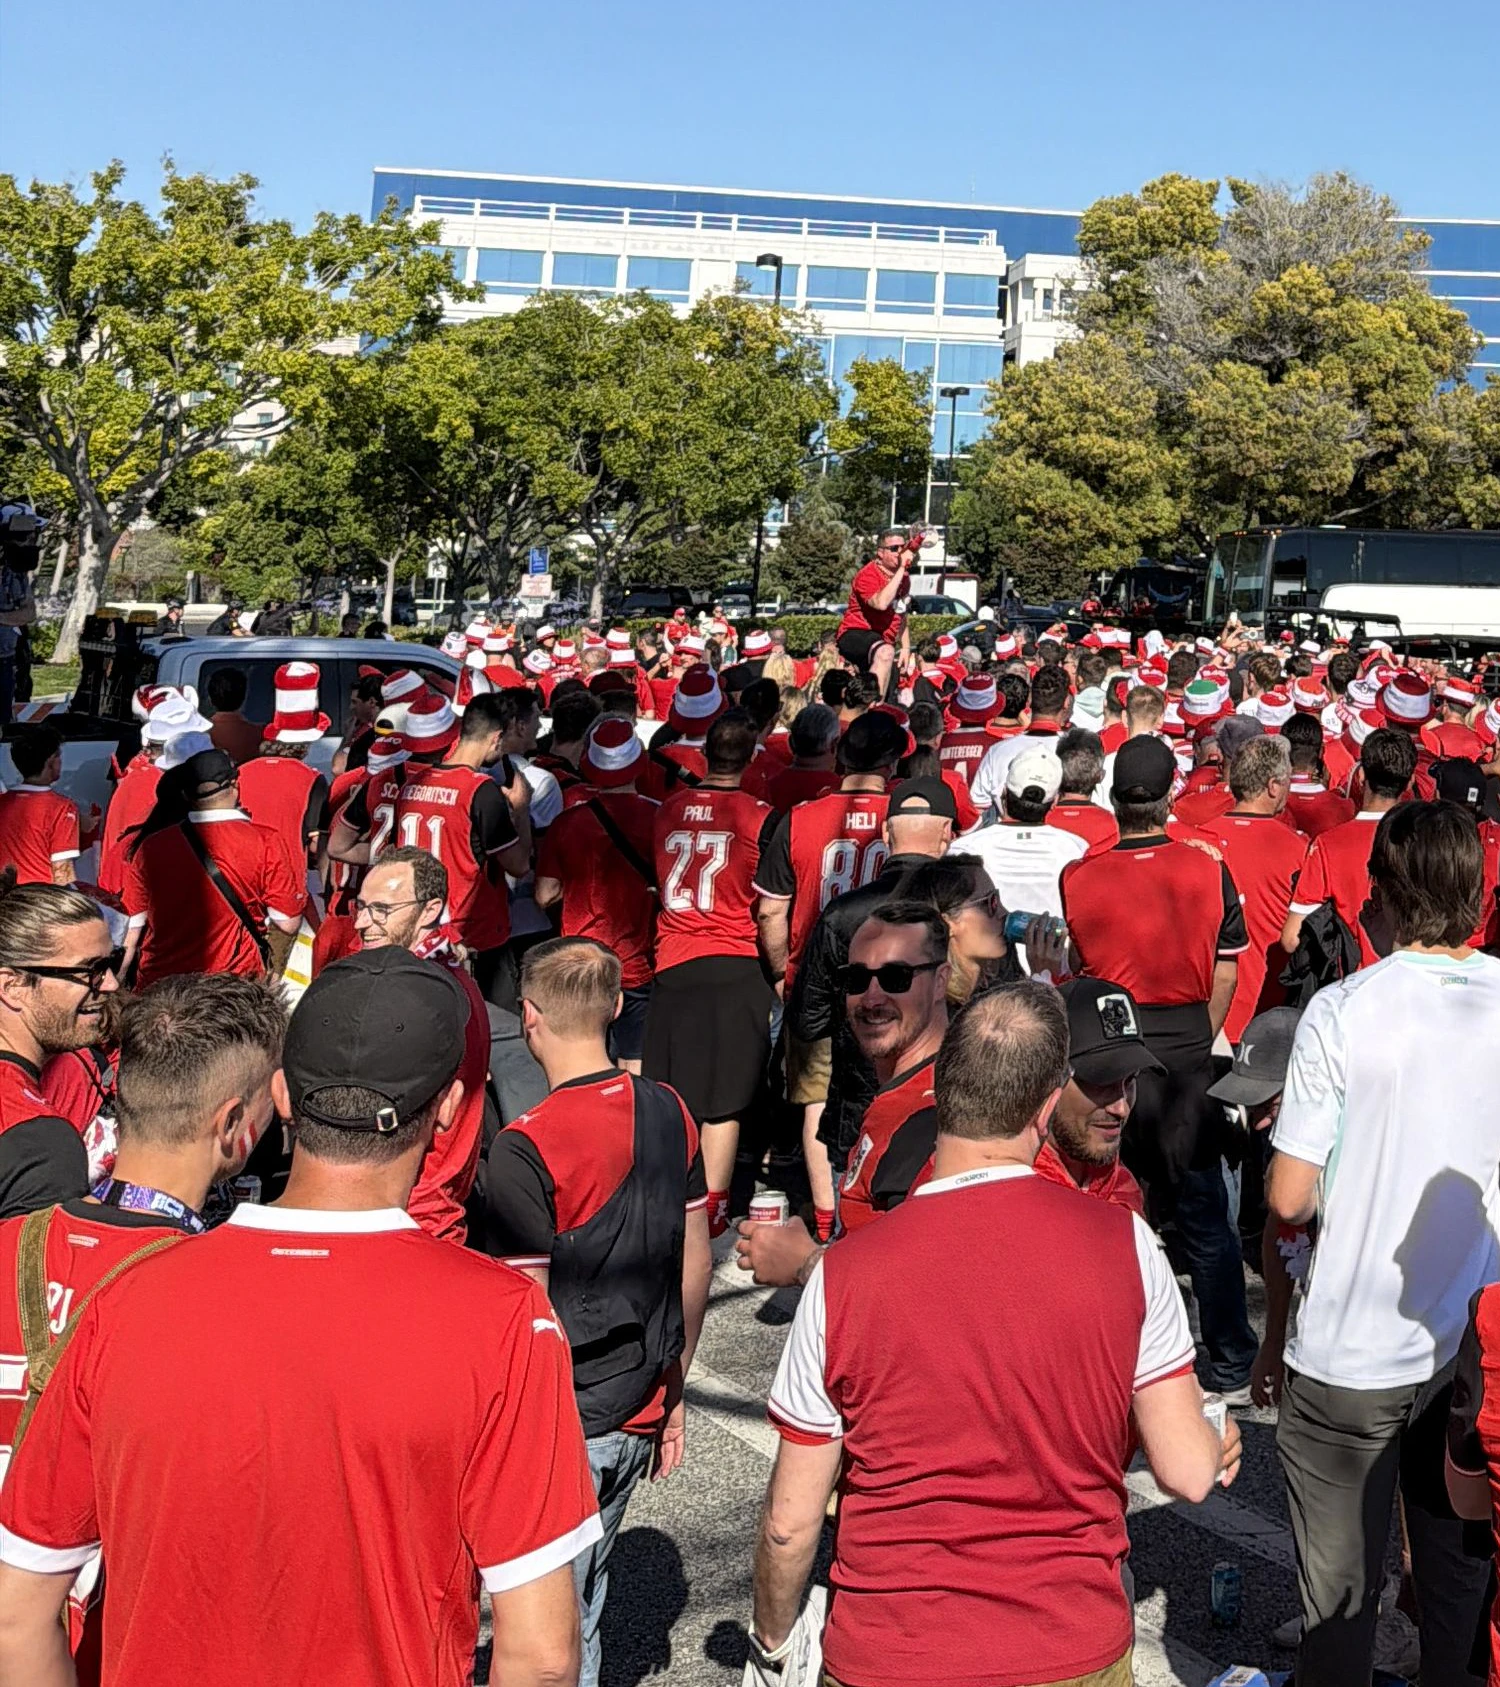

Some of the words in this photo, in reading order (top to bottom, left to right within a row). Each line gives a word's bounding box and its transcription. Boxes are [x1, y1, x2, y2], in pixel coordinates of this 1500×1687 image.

[683, 806, 714, 822] PAUL
[845, 812, 876, 830] HELI
[401, 812, 446, 862] 11
[665, 830, 735, 913] 27
